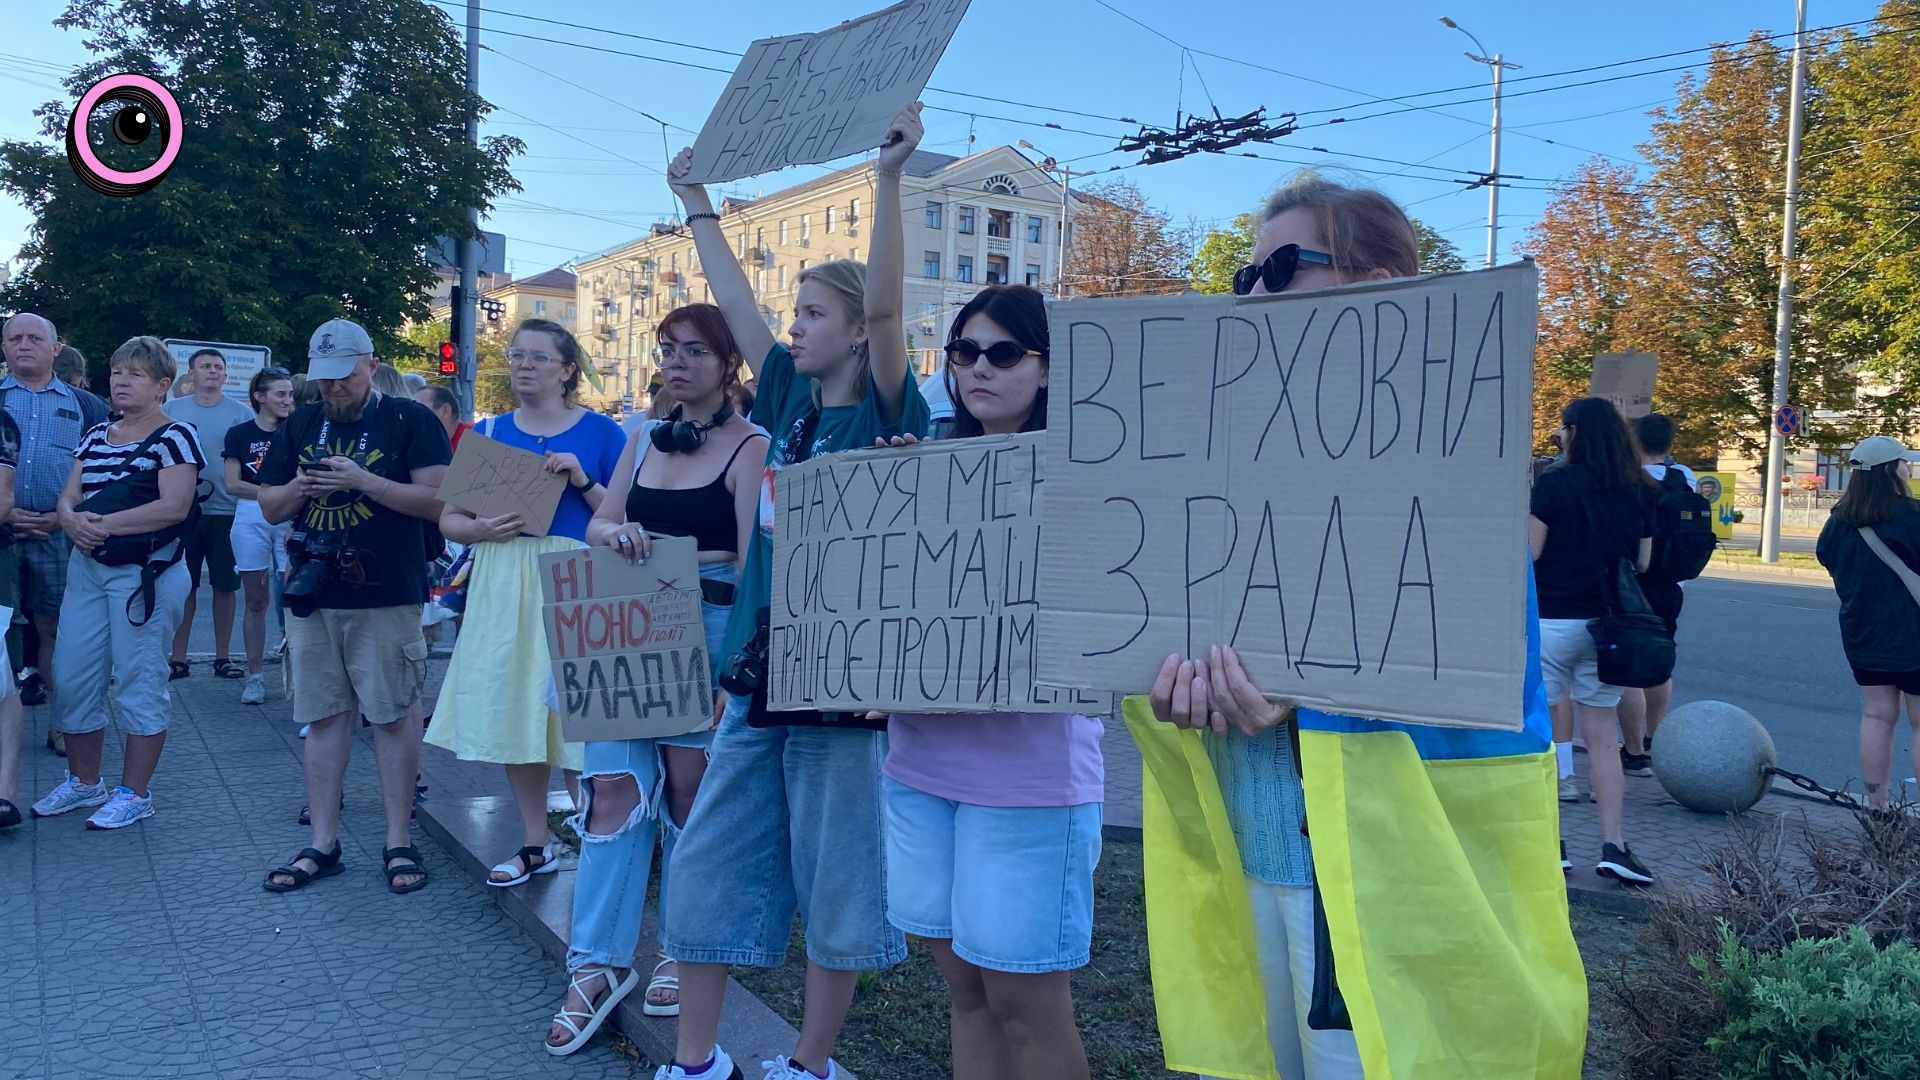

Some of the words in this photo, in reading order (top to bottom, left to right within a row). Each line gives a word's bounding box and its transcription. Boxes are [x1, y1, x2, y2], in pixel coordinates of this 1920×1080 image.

[747, 29, 851, 82] ТЕКСТ
[442, 361, 455, 372] 20
[1067, 290, 1505, 464] ВЕРХОВНА
[318, 419, 330, 445] SONY
[786, 456, 921, 540] НАХУЯ
[785, 527, 996, 618] СИСТЕМА,
[562, 646, 711, 721] ВЛАДИ
[876, 615, 1003, 703] ПРОТИ
